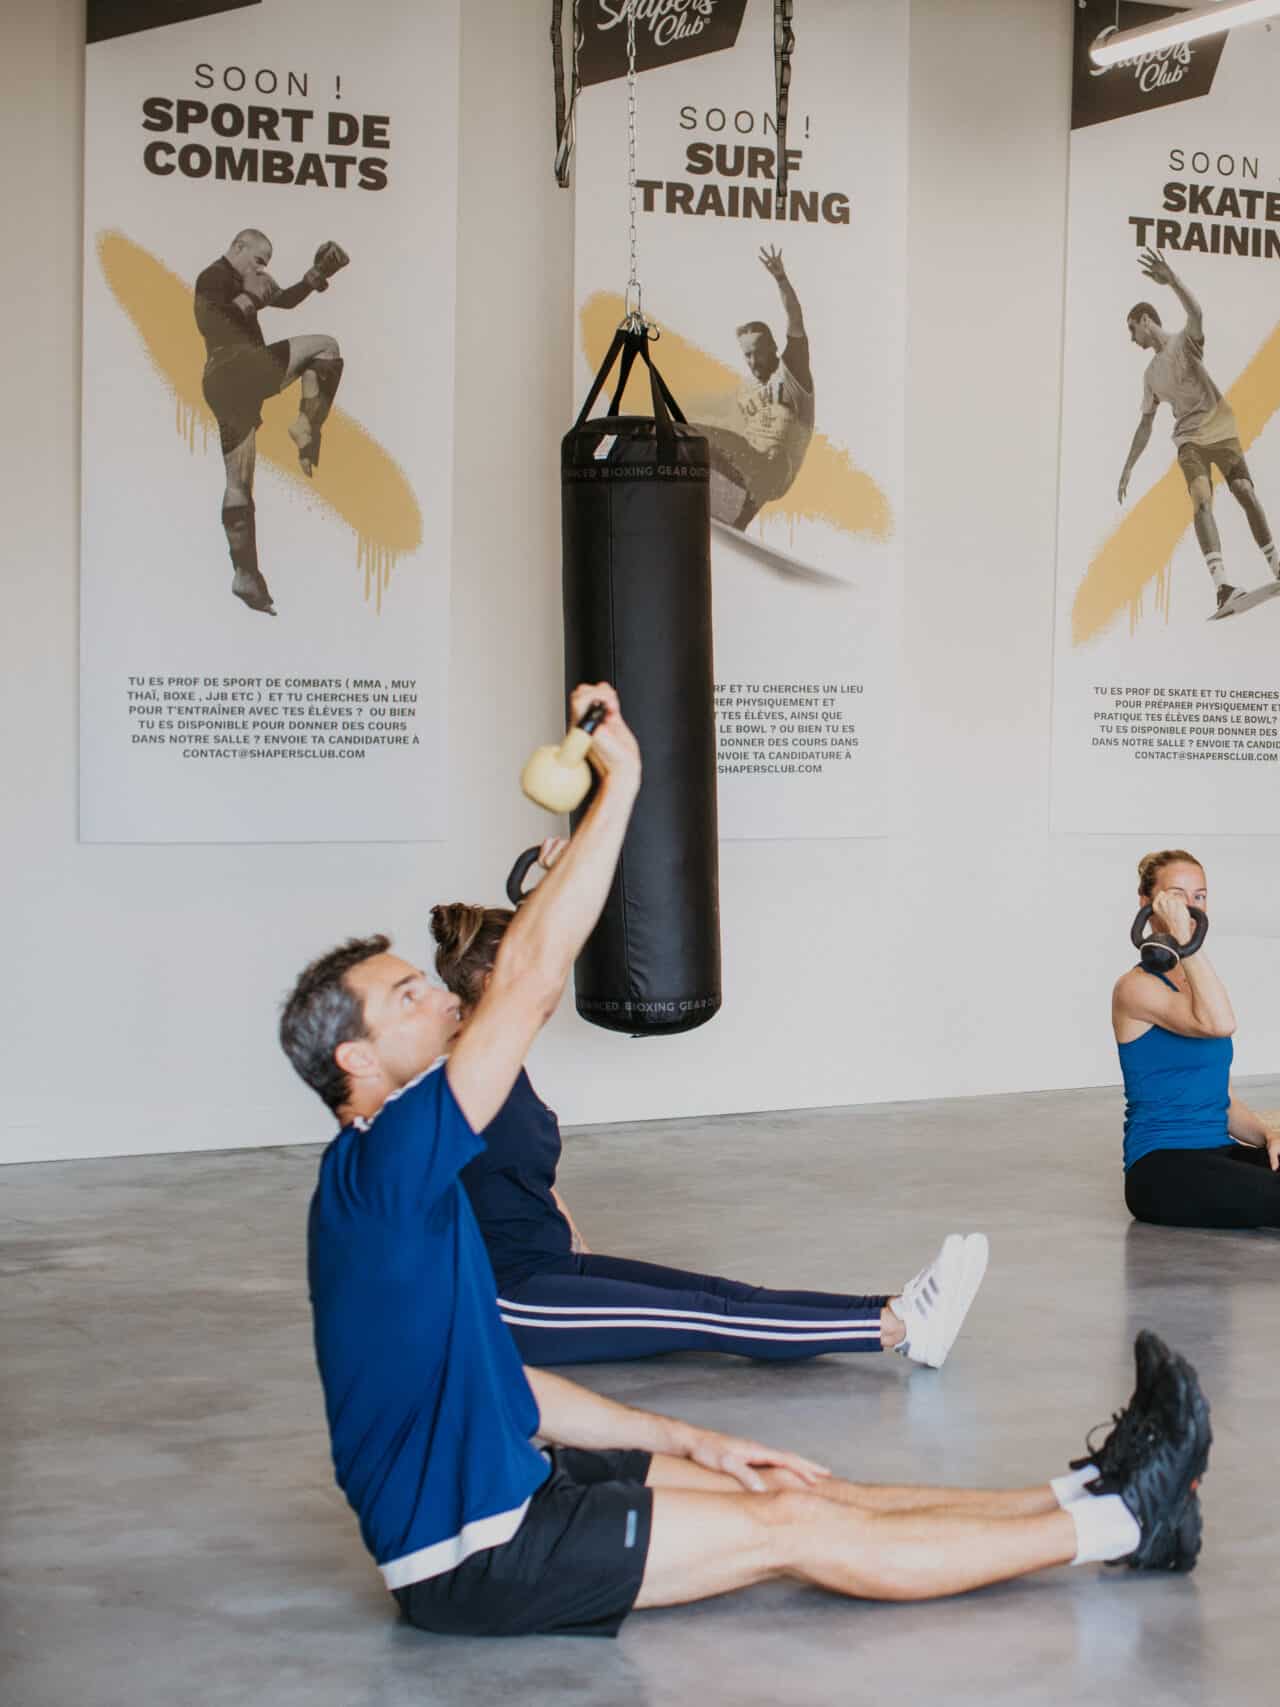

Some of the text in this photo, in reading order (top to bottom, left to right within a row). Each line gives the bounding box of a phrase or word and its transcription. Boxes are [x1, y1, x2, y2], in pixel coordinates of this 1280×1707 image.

[654, 11, 704, 46] Club
[194, 63, 308, 97] SOON
[1139, 60, 1183, 92] Club
[141, 97, 390, 149] SPORT DE
[679, 106, 778, 135] SOON
[143, 141, 388, 191] COMBATS
[685, 142, 802, 180] SURF
[1169, 149, 1258, 179] SOON
[128, 677, 416, 689] TU ES PROF DE SPORT DE COMBATS MMA MUY
[730, 685, 743, 693] ET
[746, 685, 760, 693] TU
[762, 685, 820, 694] CHERCHES
[822, 686, 837, 694] UN
[840, 686, 863, 694] LIEU
[1110, 688, 1122, 696] ES
[1153, 689, 1165, 697] DE
[1200, 690, 1212, 698] ET
[1214, 690, 1227, 698] TU
[1229, 691, 1279, 699] CHERCHES
[163, 692, 195, 701] BOXE
[205, 692, 228, 702] JJB
[231, 692, 254, 702] ETC
[268, 692, 283, 702] ET
[286, 692, 302, 702] TU
[306, 693, 369, 702] CHERCHES
[372, 693, 389, 702] UN
[392, 693, 417, 703] LIEU
[736, 699, 820, 708] PHYSIQUEMENT
[1115, 700, 1142, 708] POUR
[1195, 702, 1268, 713] PHYSIQUEMENT
[129, 706, 162, 715] POUR
[248, 706, 279, 716] AVEC
[282, 707, 304, 716] TES
[369, 707, 386, 716] OU
[389, 707, 415, 717] BIEN
[721, 712, 741, 720] TES
[790, 712, 818, 720] AINSI
[821, 712, 842, 721] QUE
[1094, 712, 1142, 723] PRATIQUE
[1144, 714, 1162, 722] TES
[1202, 715, 1228, 723] DANS
[138, 720, 406, 731] TU ES DISPONIBLE POUR DONNER DES COURS
[1115, 726, 1128, 734] ES
[1130, 727, 1186, 735] DISPONIBLE
[1217, 728, 1256, 736] DONNER
[1258, 729, 1278, 737] DES
[132, 734, 165, 744] DANS
[169, 735, 209, 744] NOTRE
[213, 735, 250, 744] SALLE
[264, 735, 307, 744] ENVOIE
[311, 736, 325, 744] TA
[328, 736, 409, 745] CANDIDATURE
[1092, 738, 1119, 746] DANS
[1121, 739, 1154, 747] NOTRE
[1196, 740, 1230, 748] ENVOIE
[718, 752, 842, 760] NVOIE TA CANDIDATURE
